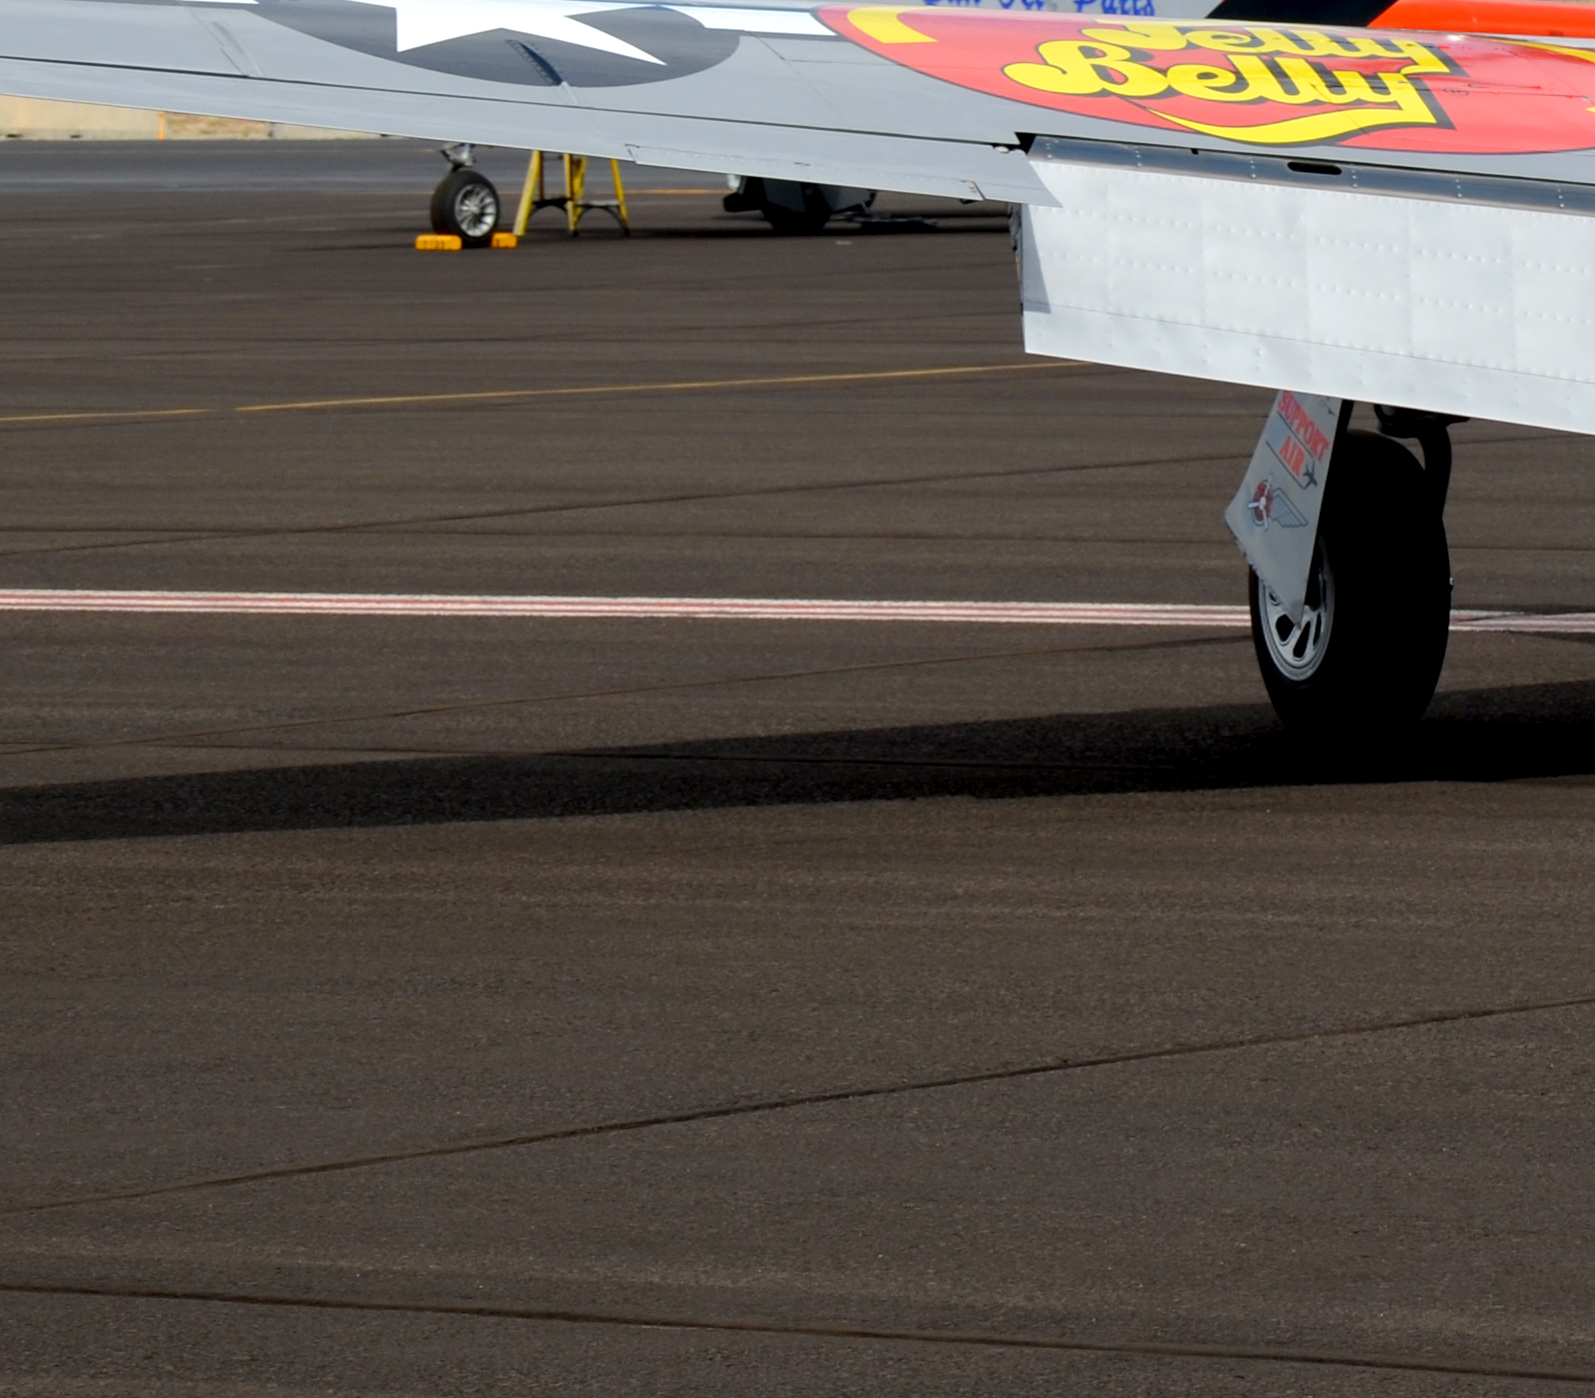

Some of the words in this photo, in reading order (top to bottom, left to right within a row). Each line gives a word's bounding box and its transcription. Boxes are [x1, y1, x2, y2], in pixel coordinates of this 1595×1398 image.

[1080, 19, 1452, 77] Jelly
[1001, 39, 1438, 144] Belly
[1278, 390, 1330, 463] SUPPORT
[1280, 435, 1306, 477] AIR
